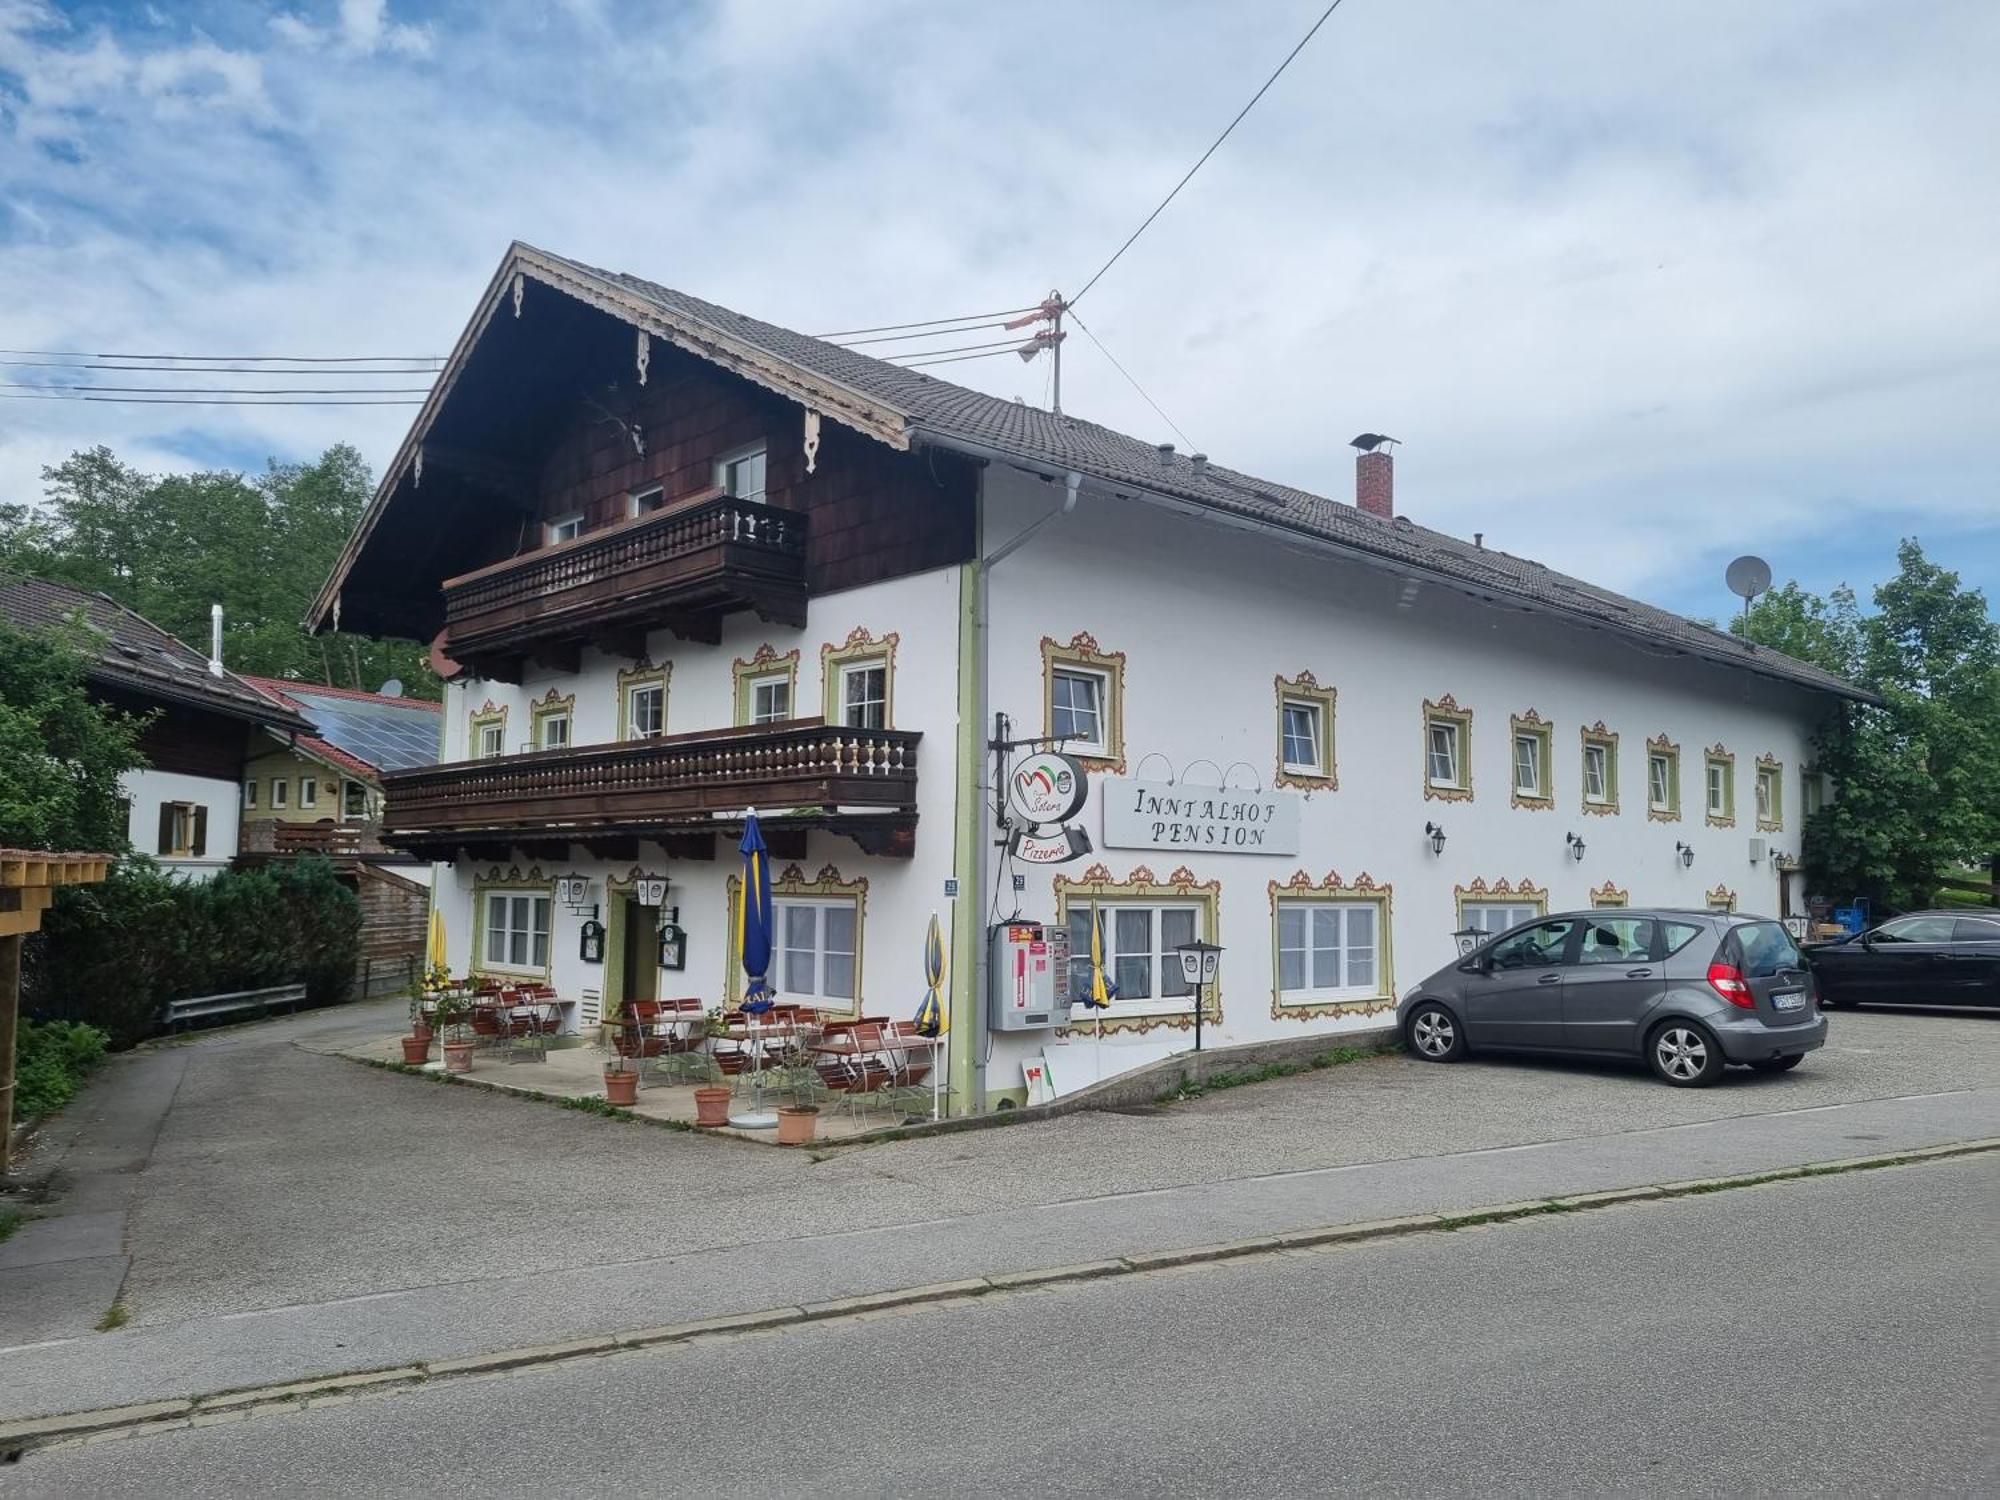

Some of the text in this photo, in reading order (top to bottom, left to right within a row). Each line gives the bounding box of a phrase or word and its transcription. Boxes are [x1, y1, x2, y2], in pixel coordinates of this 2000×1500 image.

[1134, 789, 1275, 823] INNTALHOF
[1152, 822, 1265, 845] PENSION
[1023, 840, 1065, 860] Pizzeria
